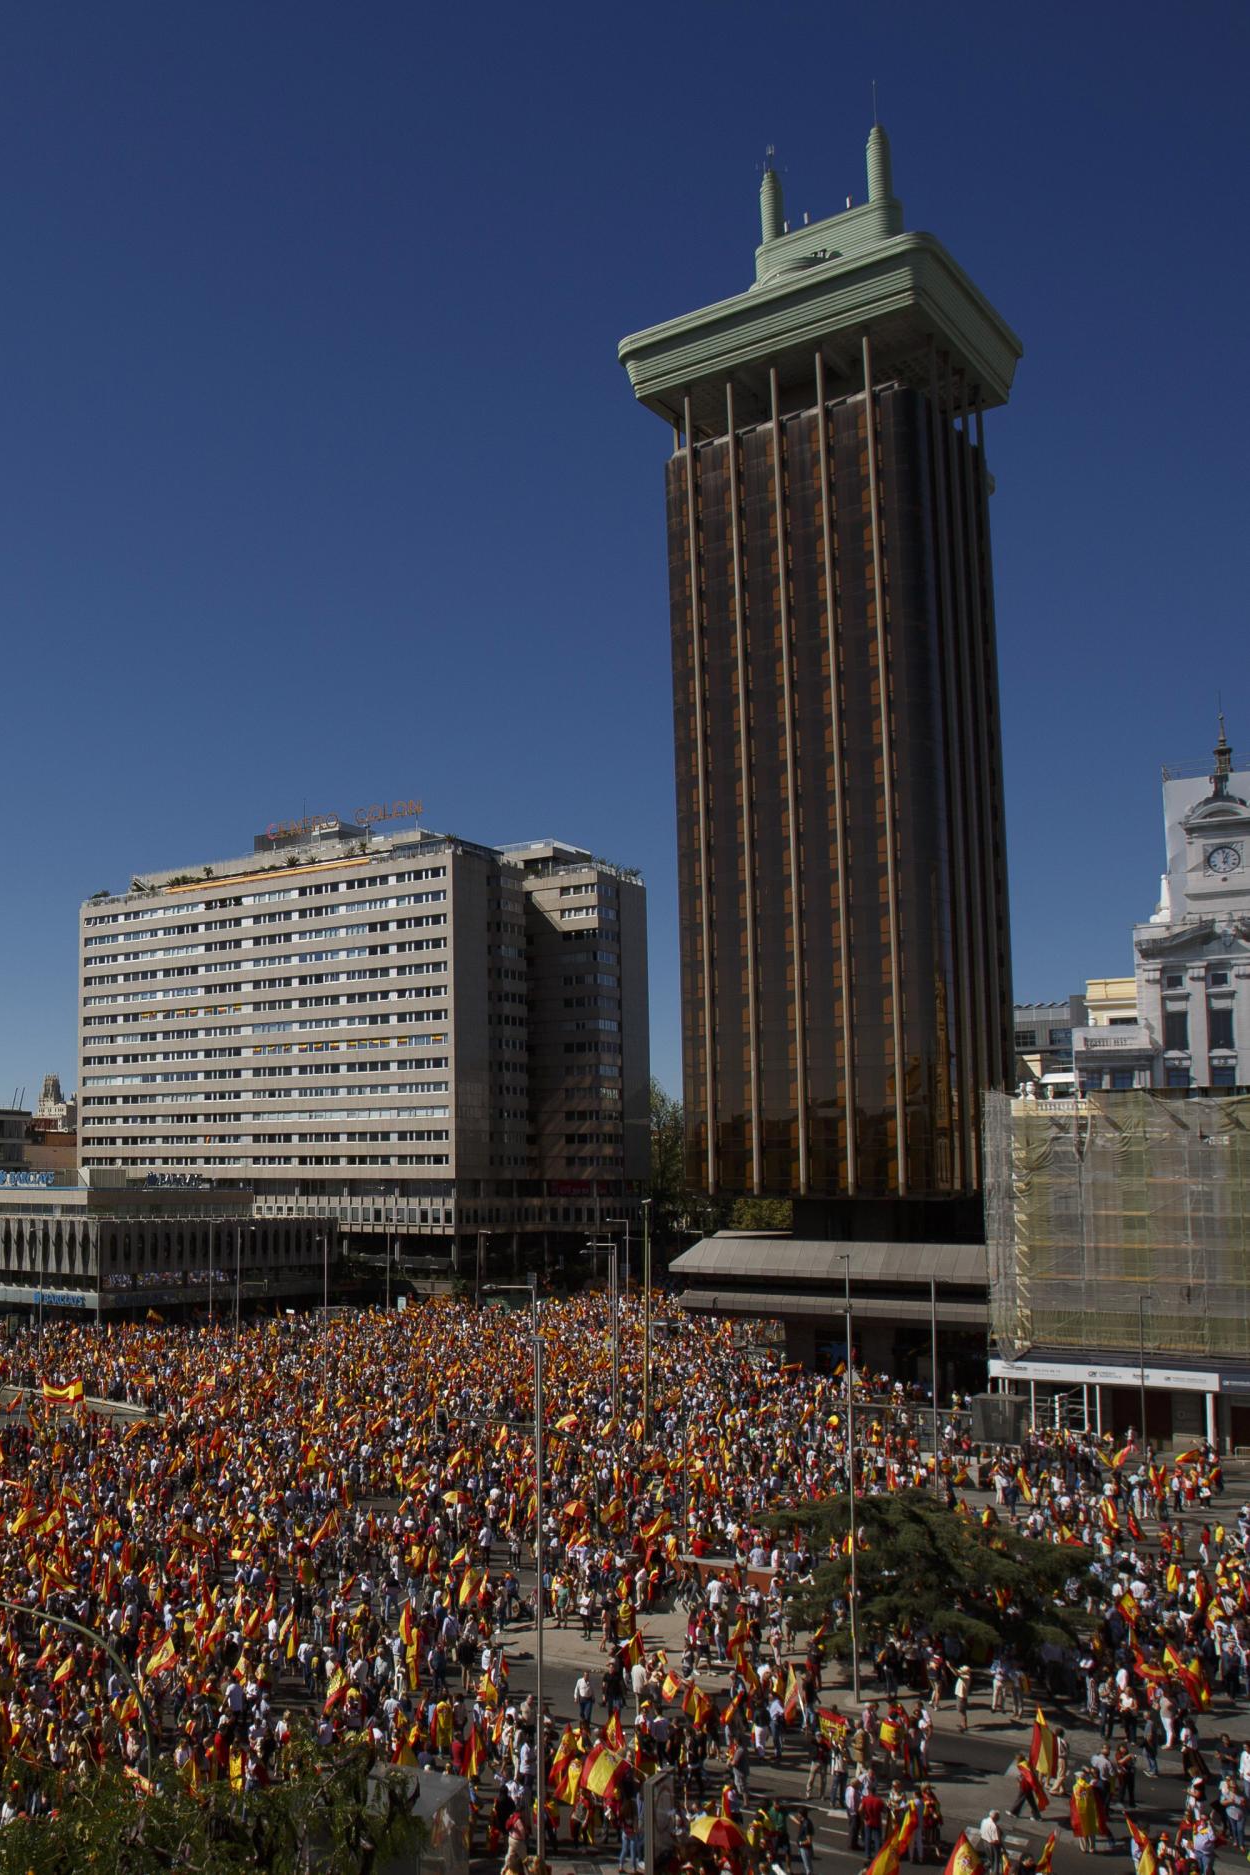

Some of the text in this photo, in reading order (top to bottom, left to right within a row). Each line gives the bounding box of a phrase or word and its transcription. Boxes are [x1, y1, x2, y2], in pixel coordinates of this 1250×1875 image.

[266, 813, 339, 840] CENTRO
[9, 1171, 55, 1185] BARCLAYS
[158, 1173, 204, 1186] BARCLAYS
[43, 1293, 85, 1306] BARCLAYS
